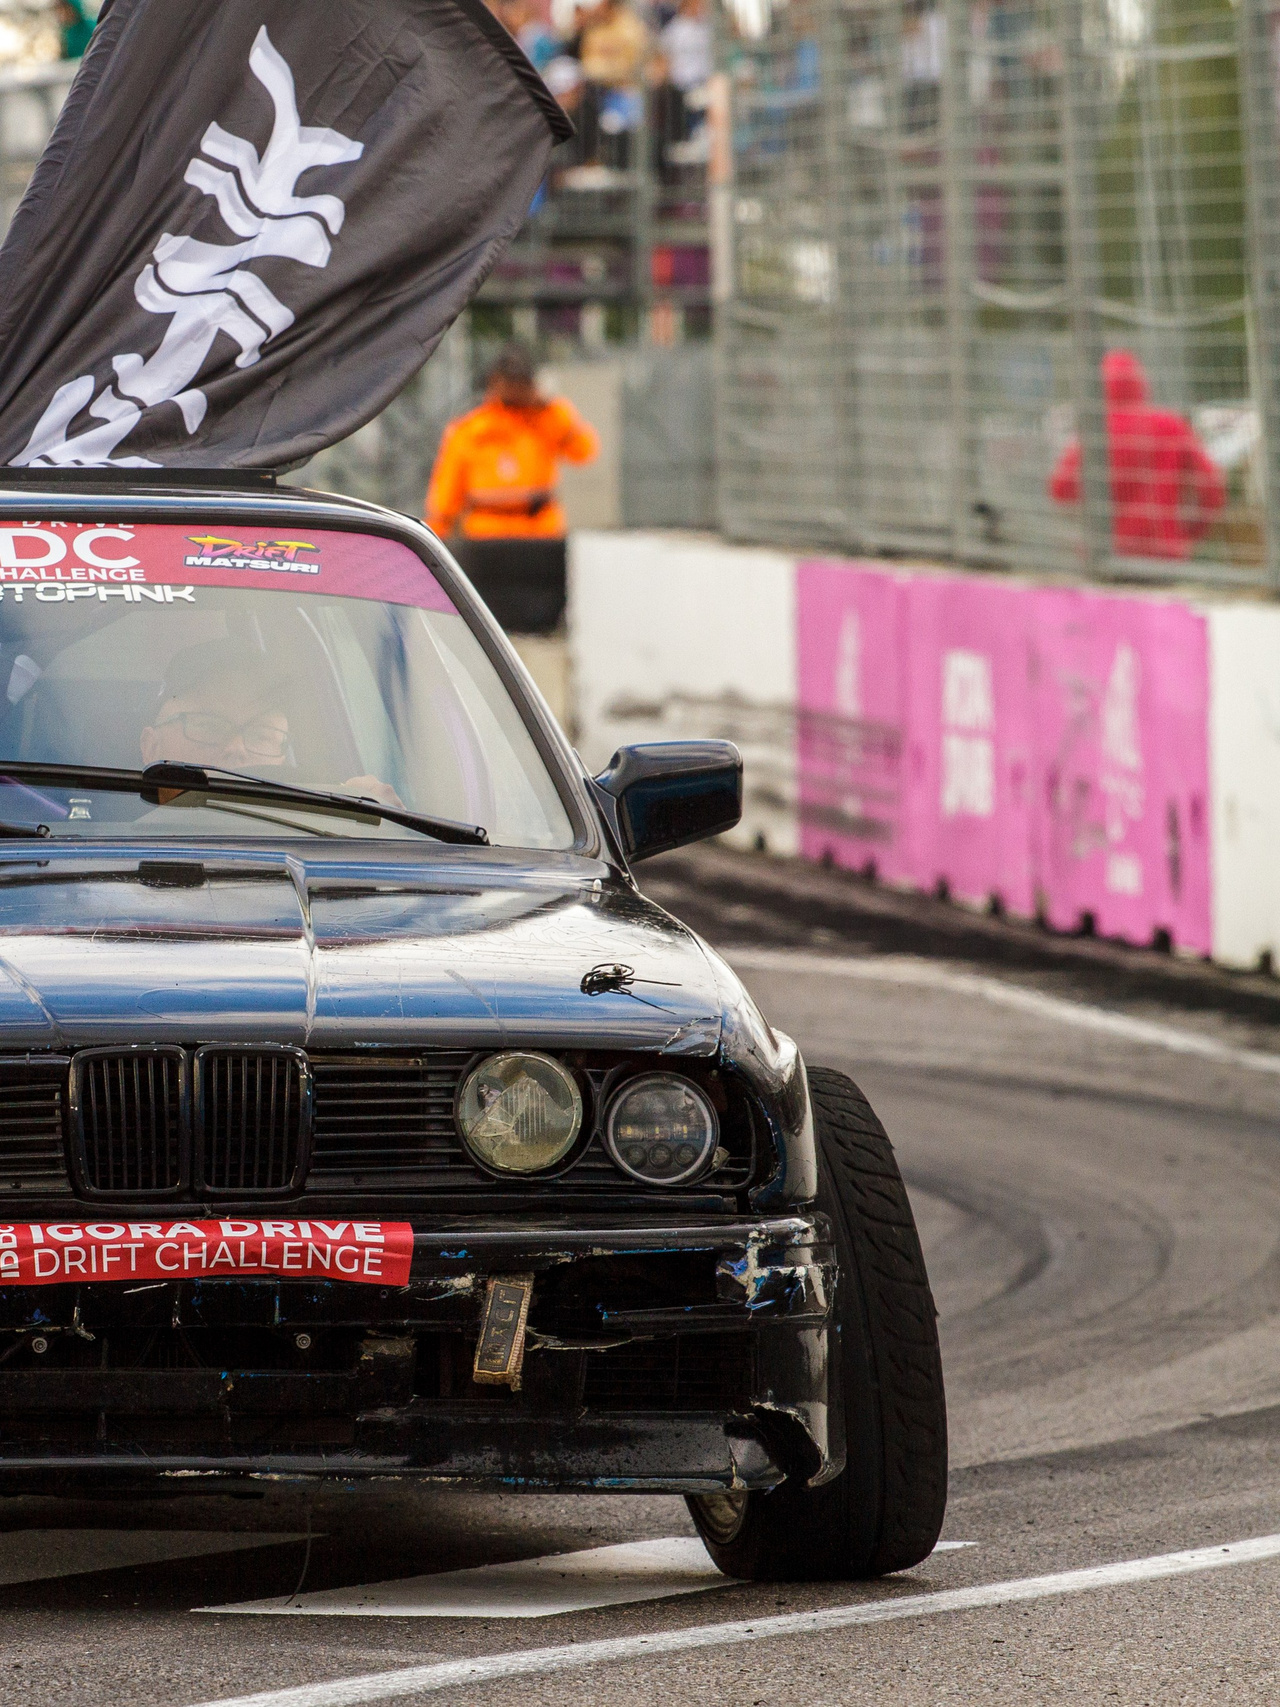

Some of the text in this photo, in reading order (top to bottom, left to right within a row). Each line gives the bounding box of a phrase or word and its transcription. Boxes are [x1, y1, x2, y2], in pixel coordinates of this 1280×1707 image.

[185, 556, 320, 574] MATSURI
[29, 1220, 385, 1244] IGORA DRIVE
[34, 1240, 383, 1278] DRIFT CHALLENGE
